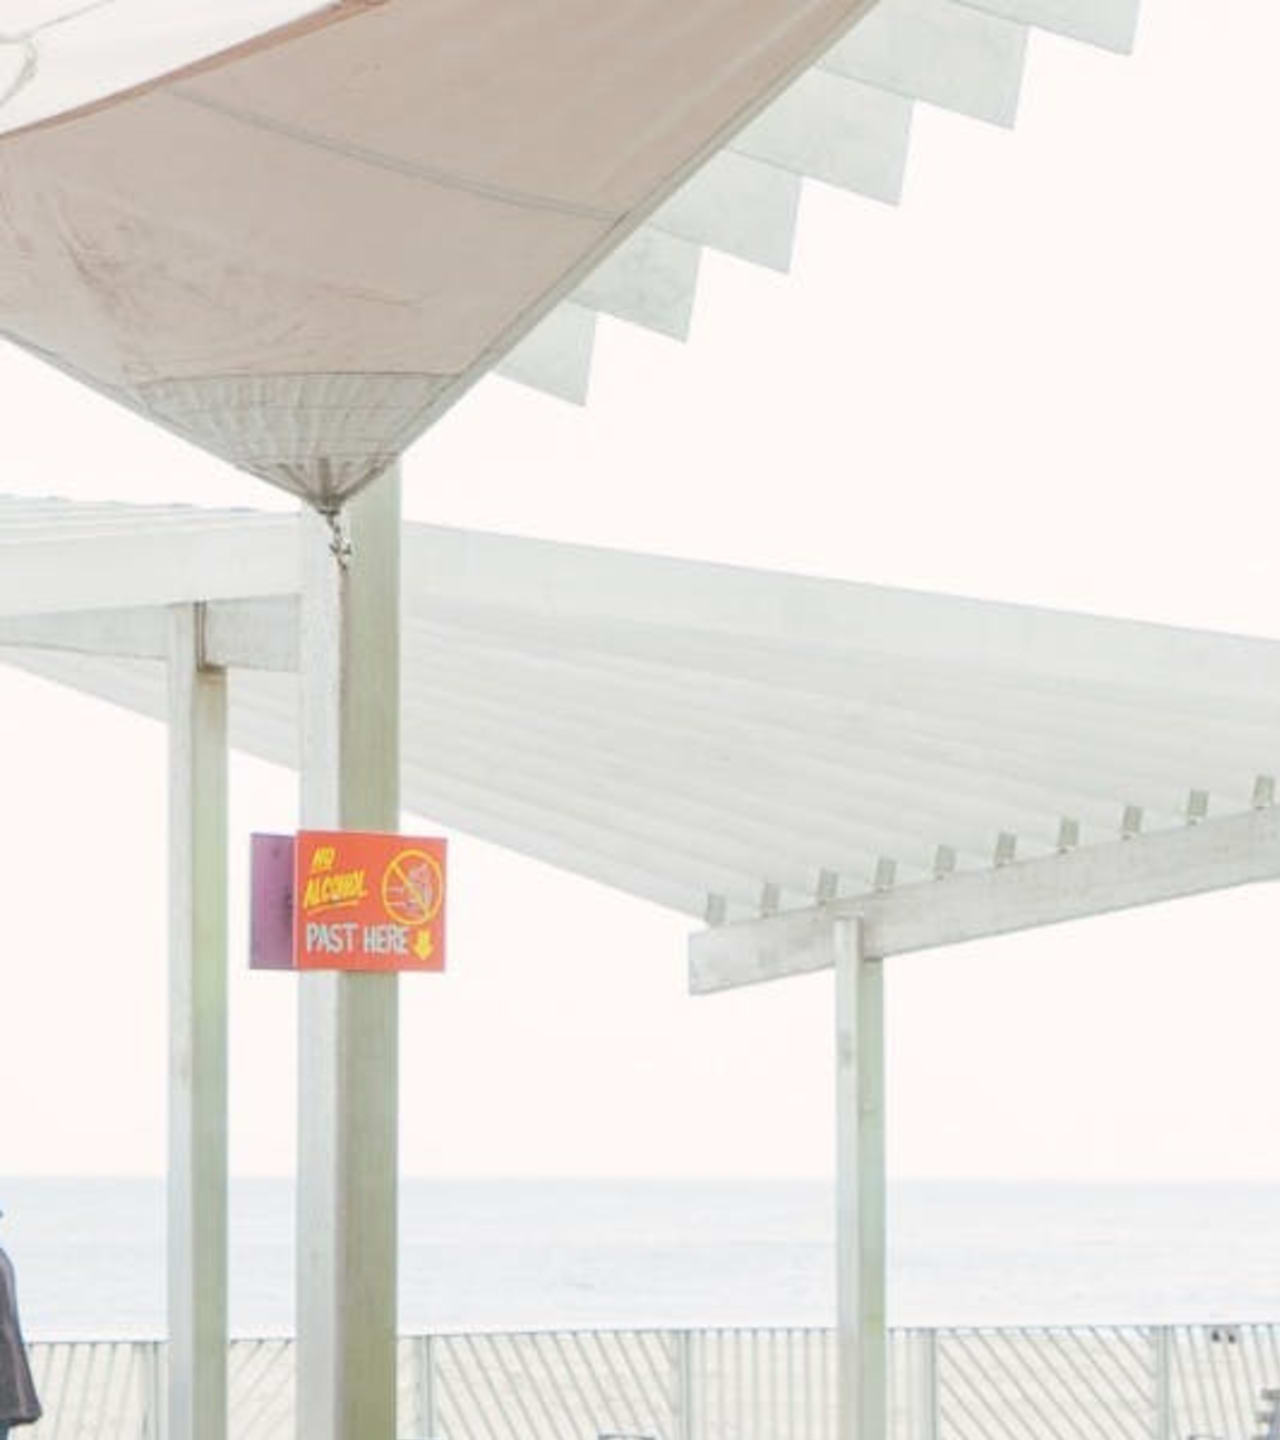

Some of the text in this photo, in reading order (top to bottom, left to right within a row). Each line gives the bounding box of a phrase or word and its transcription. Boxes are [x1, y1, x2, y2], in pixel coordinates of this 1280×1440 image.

[312, 846, 336, 874] NO
[303, 869, 368, 909] ALCOHOL
[306, 921, 408, 954] PAST HERE
